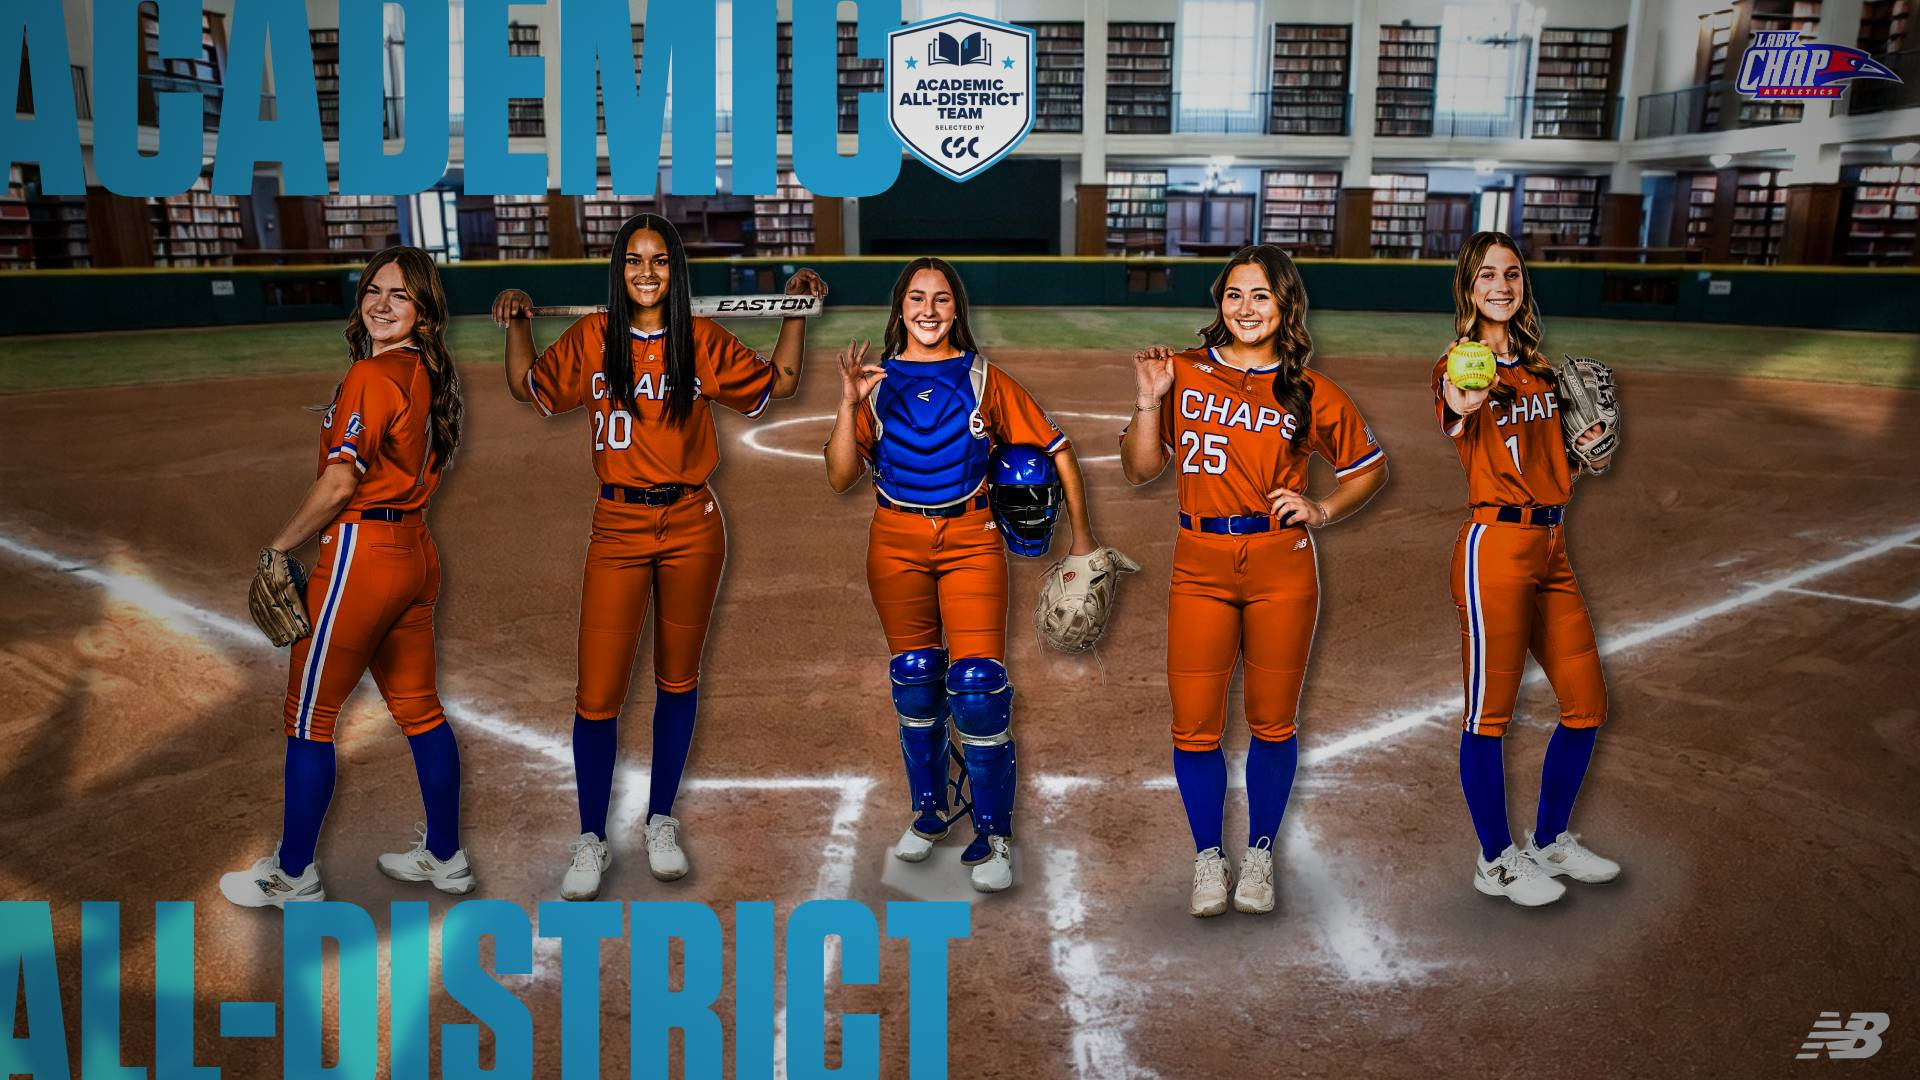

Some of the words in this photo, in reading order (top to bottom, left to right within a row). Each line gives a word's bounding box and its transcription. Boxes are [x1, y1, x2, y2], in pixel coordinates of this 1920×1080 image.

[717, 298, 815, 312] EASTON
[593, 408, 633, 451] 20
[1179, 387, 1297, 441] CHAPS
[1179, 430, 1230, 476] 25
[1504, 434, 1523, 475] 1
